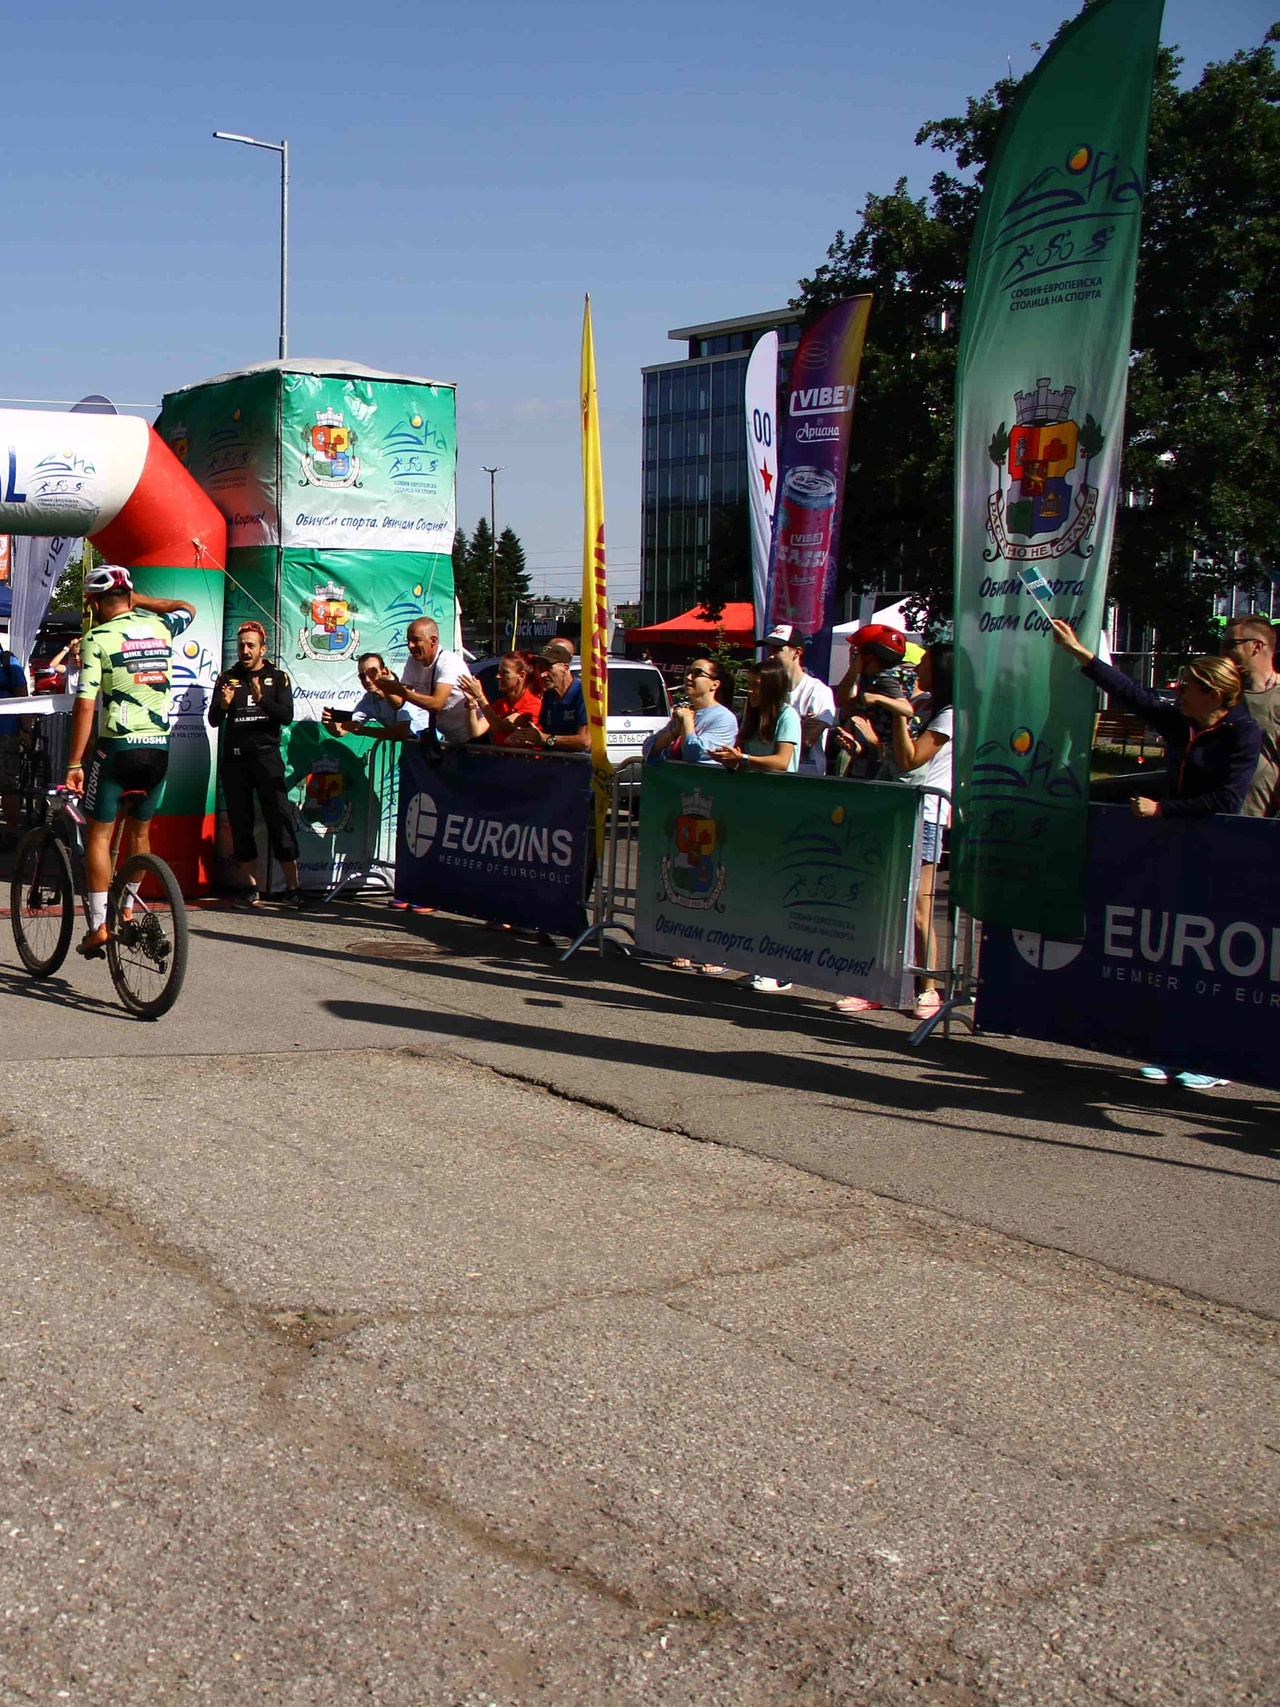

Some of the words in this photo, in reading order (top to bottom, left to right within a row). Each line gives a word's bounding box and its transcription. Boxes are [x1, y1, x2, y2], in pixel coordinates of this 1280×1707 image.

[1010, 297, 1050, 312] СТОЛИЦА
[1051, 294, 1064, 305] НА
[1065, 289, 1102, 303] СПОРТА
[799, 386, 845, 408] VIBE
[796, 423, 839, 443] Ариана
[341, 516, 379, 531] спорта.
[416, 518, 448, 533] София!
[123, 651, 142, 659] BIKE
[124, 640, 165, 651] VITOSHA
[126, 736, 167, 744] VITOSHA
[619, 734, 636, 743] 8766
[85, 761, 101, 811] VITOSHA
[442, 813, 573, 867] EUROINS
[439, 854, 483, 871] MEMBER
[486, 864, 500, 874] OF
[502, 865, 572, 885] EUROHOLD
[656, 914, 702, 941] Обичам
[706, 927, 754, 953] спорта.
[759, 934, 813, 964] Обичам
[817, 947, 876, 977] София!
[1196, 981, 1221, 996] OF
